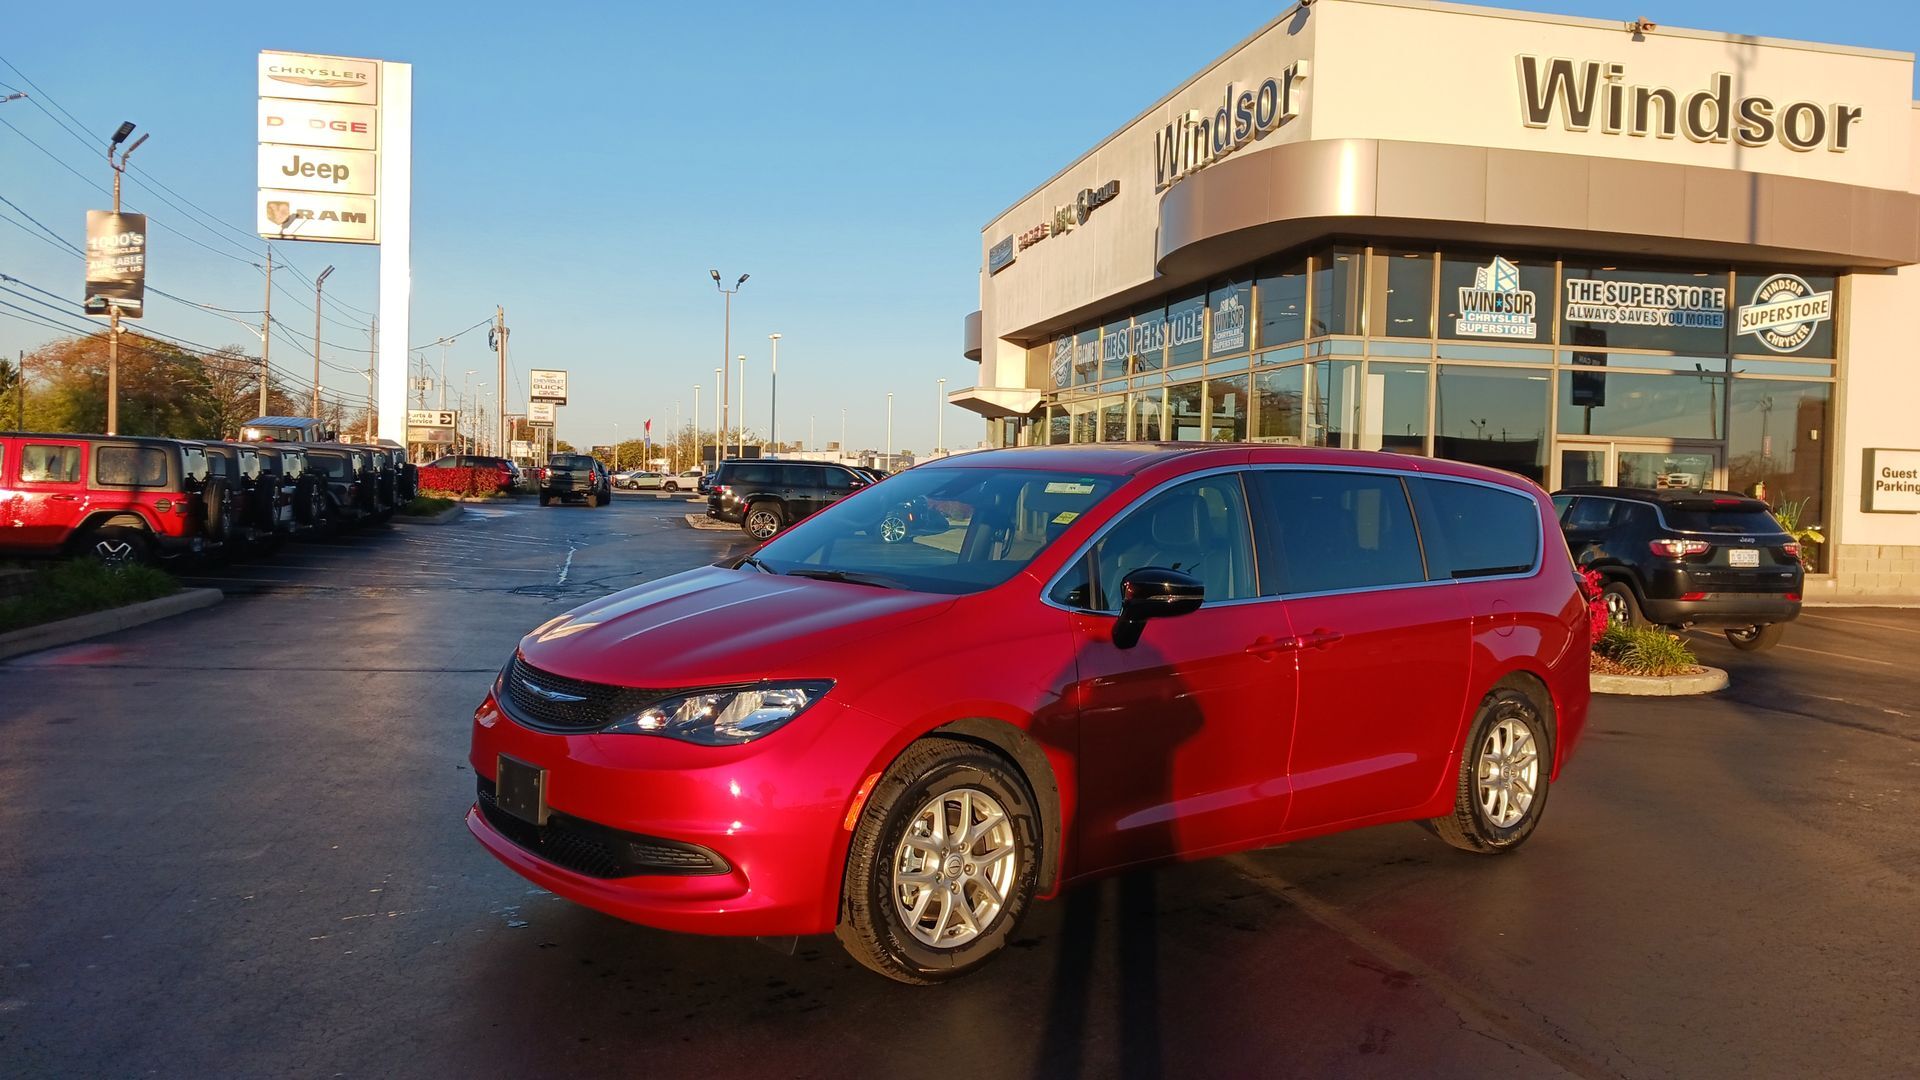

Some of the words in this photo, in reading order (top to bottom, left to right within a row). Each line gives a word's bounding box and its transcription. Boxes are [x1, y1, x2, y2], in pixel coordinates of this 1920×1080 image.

[268, 65, 367, 80] CHRYSLER
[1515, 53, 1863, 152] Windsor
[266, 116, 368, 133] DDGE
[1154, 59, 1308, 187] Windsor
[282, 155, 350, 184] Jeep
[296, 209, 367, 224] RAM
[1569, 281, 1602, 301] THE
[1606, 284, 1724, 309] SUPERSTORE
[1760, 280, 1804, 300] WINDSOR
[1462, 291, 1532, 314] WINDSOR
[1467, 313, 1526, 324] CHRYSLER
[1568, 307, 1616, 321] ALWAYS
[1619, 309, 1658, 322] SAVES
[1661, 311, 1684, 325] YOU
[1685, 312, 1723, 326] MORE!
[1742, 300, 1828, 327] SUPERSTORE
[1103, 333, 1117, 360] THE
[1118, 307, 1203, 359] SUPERSTORE
[1460, 323, 1534, 335] SUPERSTORE
[1766, 324, 1810, 347] CHRYSLER
[1882, 466, 1917, 479] Guest
[1876, 479, 1920, 495] Parking
[1739, 536, 1756, 544] Jeep
